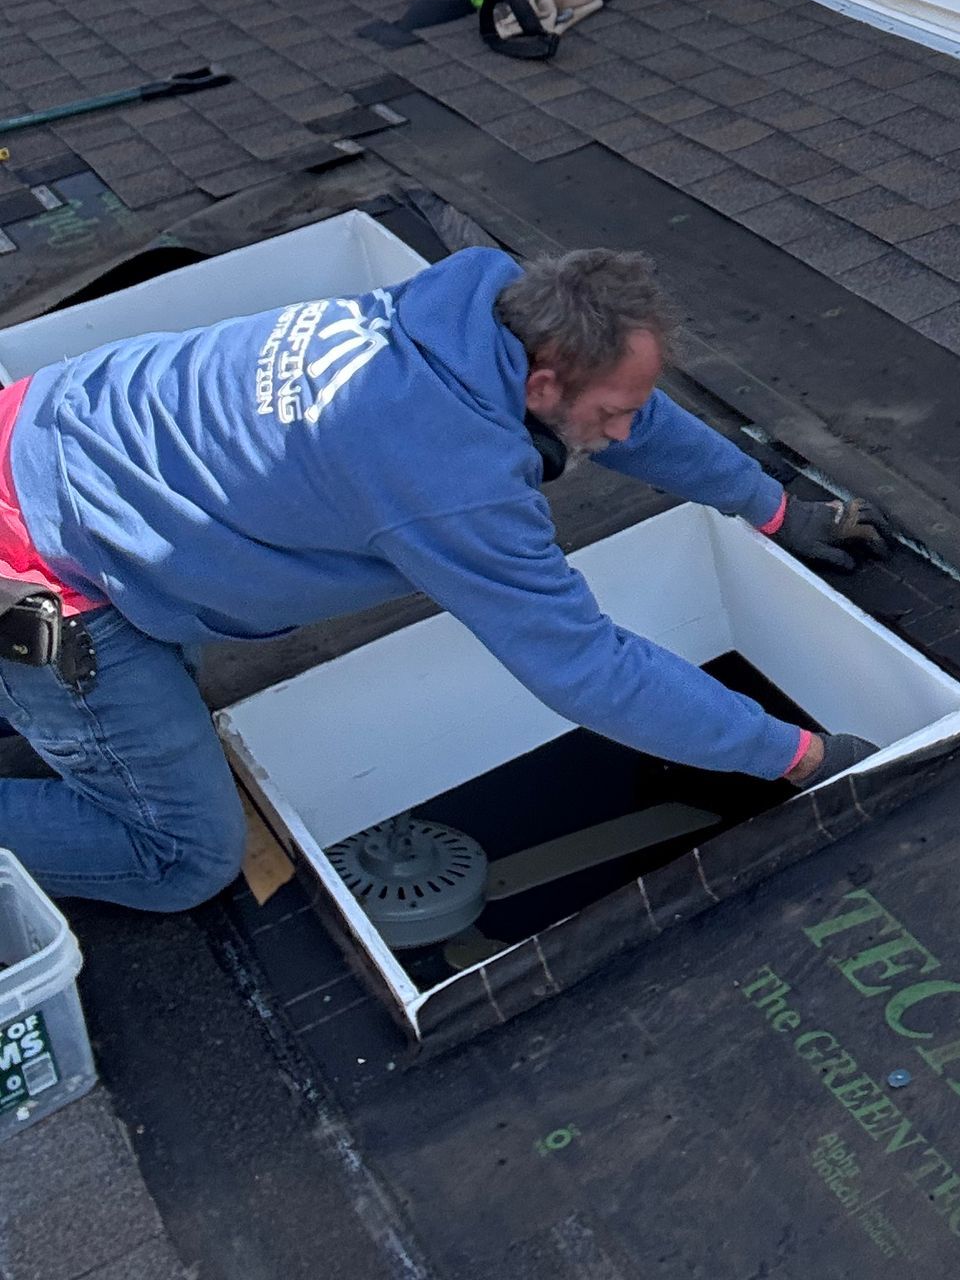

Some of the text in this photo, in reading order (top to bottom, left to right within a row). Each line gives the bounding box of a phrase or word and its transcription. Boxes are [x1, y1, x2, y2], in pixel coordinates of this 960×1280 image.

[742, 963, 801, 1033] The
[793, 1030, 928, 1154] GREEN
[817, 1131, 862, 1179] Alpha
